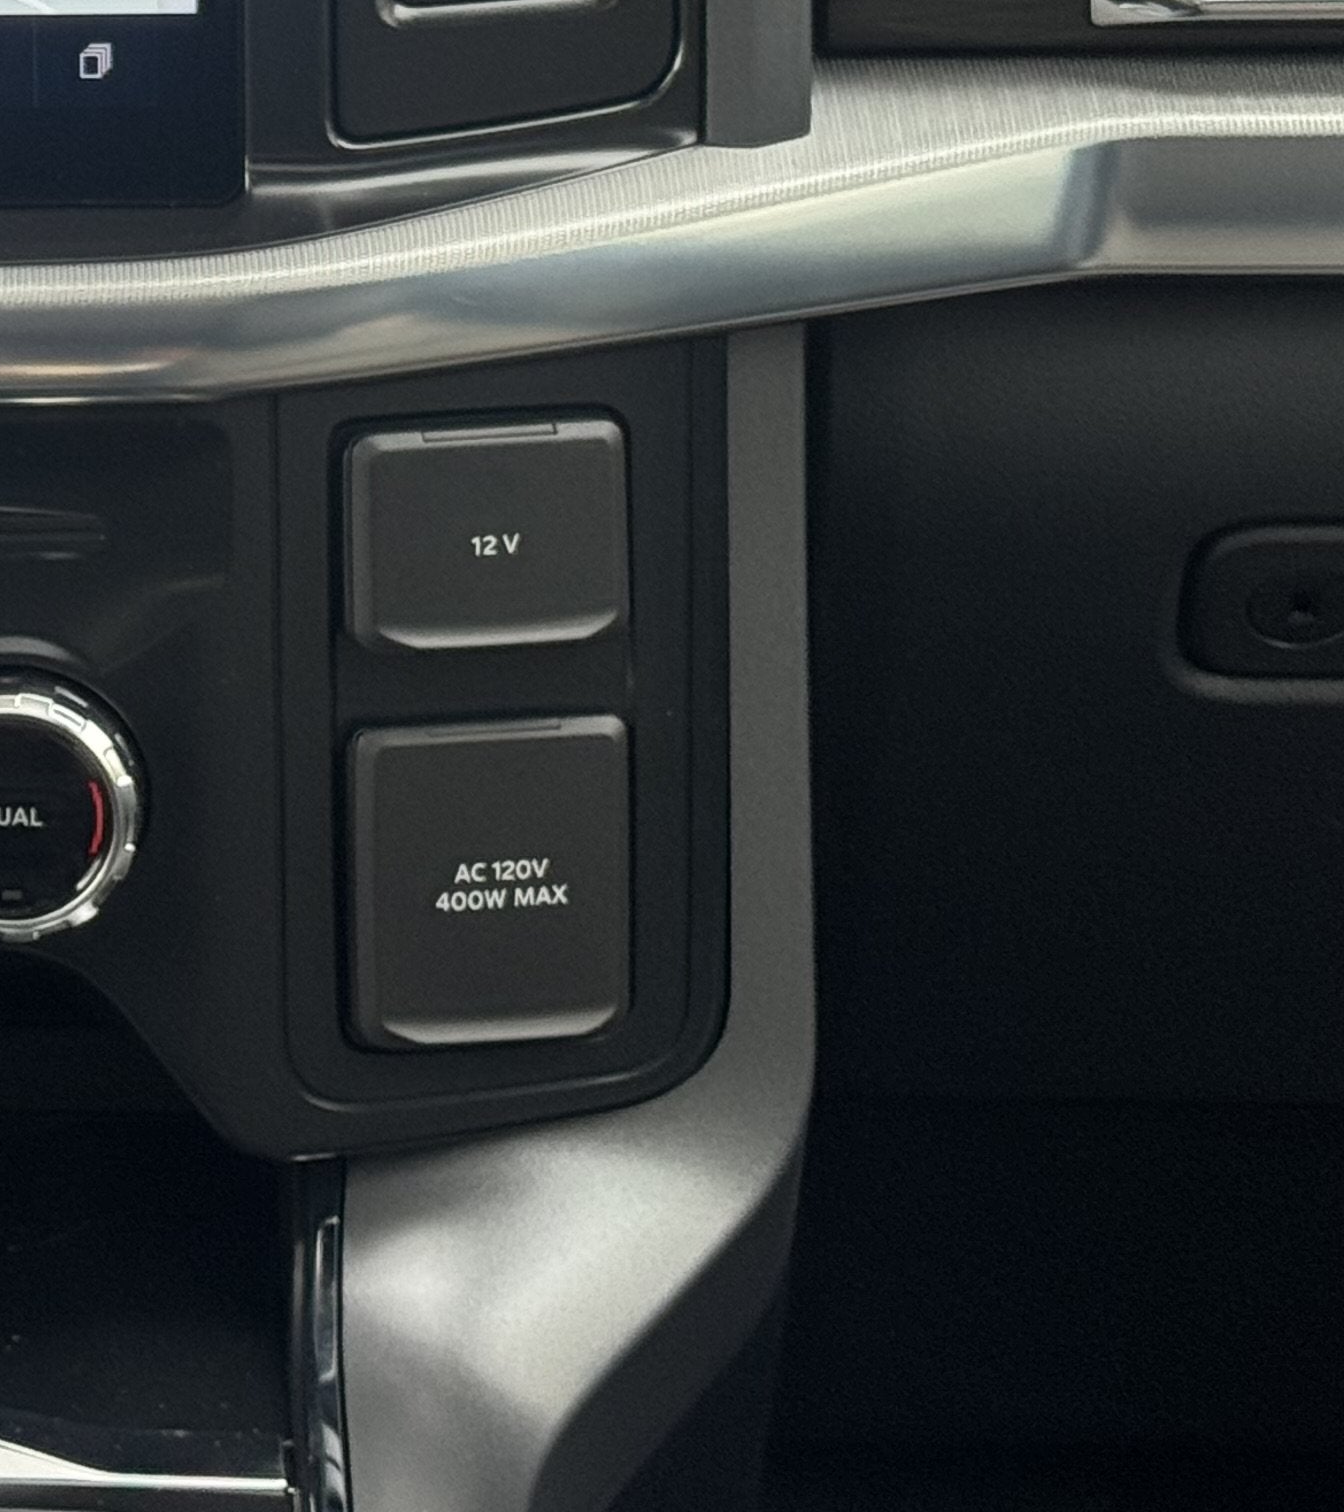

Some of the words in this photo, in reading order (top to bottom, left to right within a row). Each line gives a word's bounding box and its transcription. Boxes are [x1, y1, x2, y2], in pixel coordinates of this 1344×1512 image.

[471, 534, 499, 556] 12
[502, 532, 521, 555] V
[454, 862, 489, 885] AC
[491, 858, 550, 882] 120V
[435, 888, 511, 914] 400W
[513, 884, 569, 909] MAX
